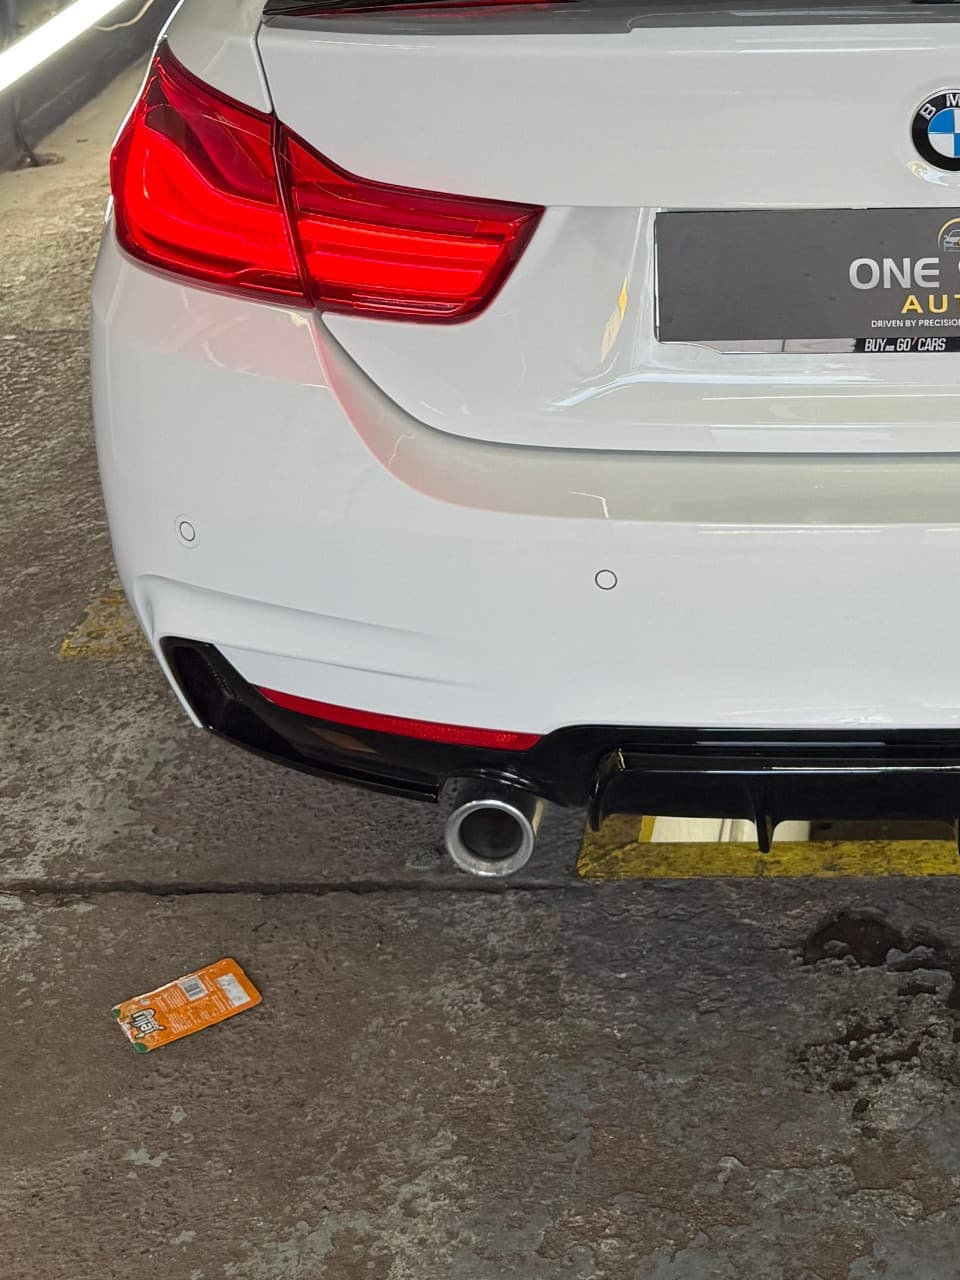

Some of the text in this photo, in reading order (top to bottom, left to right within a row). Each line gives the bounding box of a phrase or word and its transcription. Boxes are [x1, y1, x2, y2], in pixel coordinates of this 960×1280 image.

[849, 257, 940, 290] ONE
[871, 320, 904, 328] DRIVEN
[905, 319, 917, 327] BY
[865, 338, 887, 352] BUY
[917, 338, 946, 351] CARS
